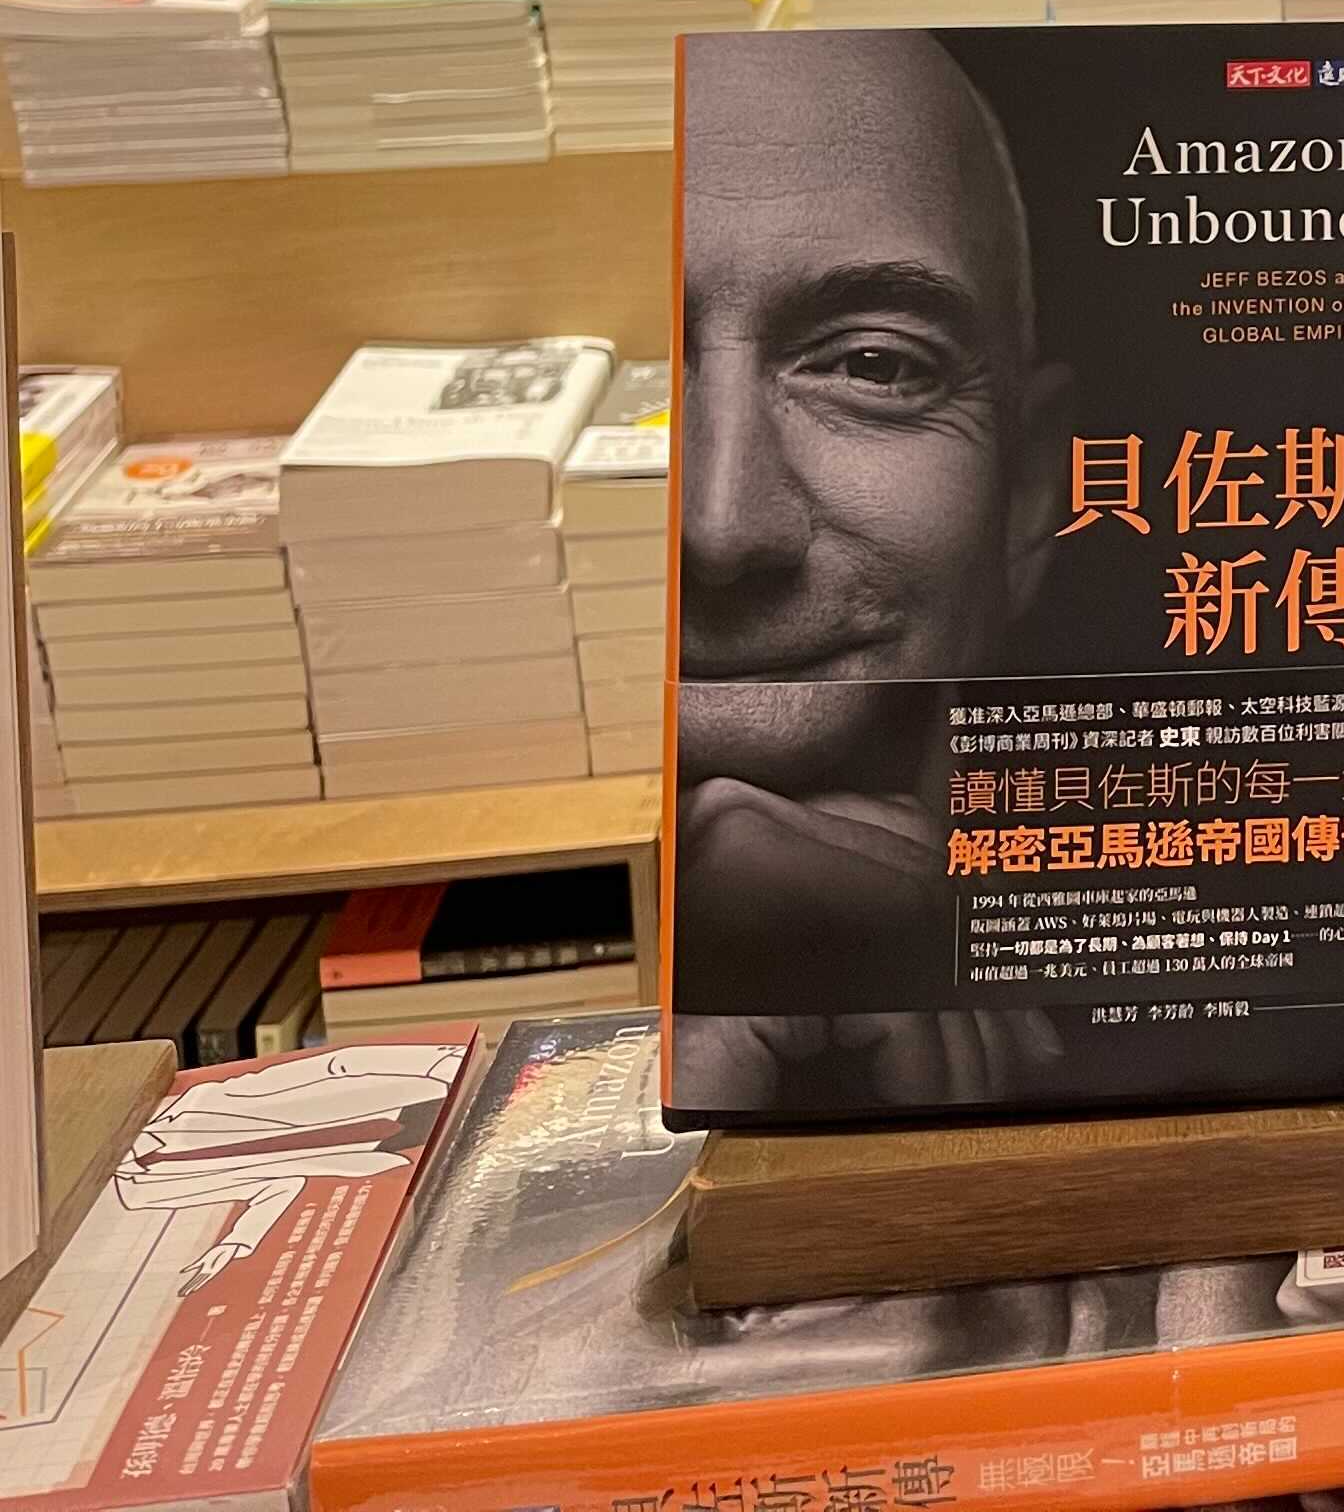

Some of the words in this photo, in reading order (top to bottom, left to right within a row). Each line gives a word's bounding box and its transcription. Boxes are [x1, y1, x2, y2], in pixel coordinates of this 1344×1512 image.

[1229, 64, 1308, 86] 天下文化
[1200, 271, 1250, 289] JEFF
[1257, 269, 1327, 287] BEZOS
[1172, 301, 1202, 316] the
[1211, 297, 1325, 315] INVENTION
[1202, 326, 1285, 344] GLOBAL
[1159, 726, 1201, 748] 史東
[971, 893, 1003, 910] 1994
[1252, 930, 1280, 947] Day
[1165, 957, 1189, 973] 130
[1141, 1438, 1297, 1480] 亞馬遜帝國
